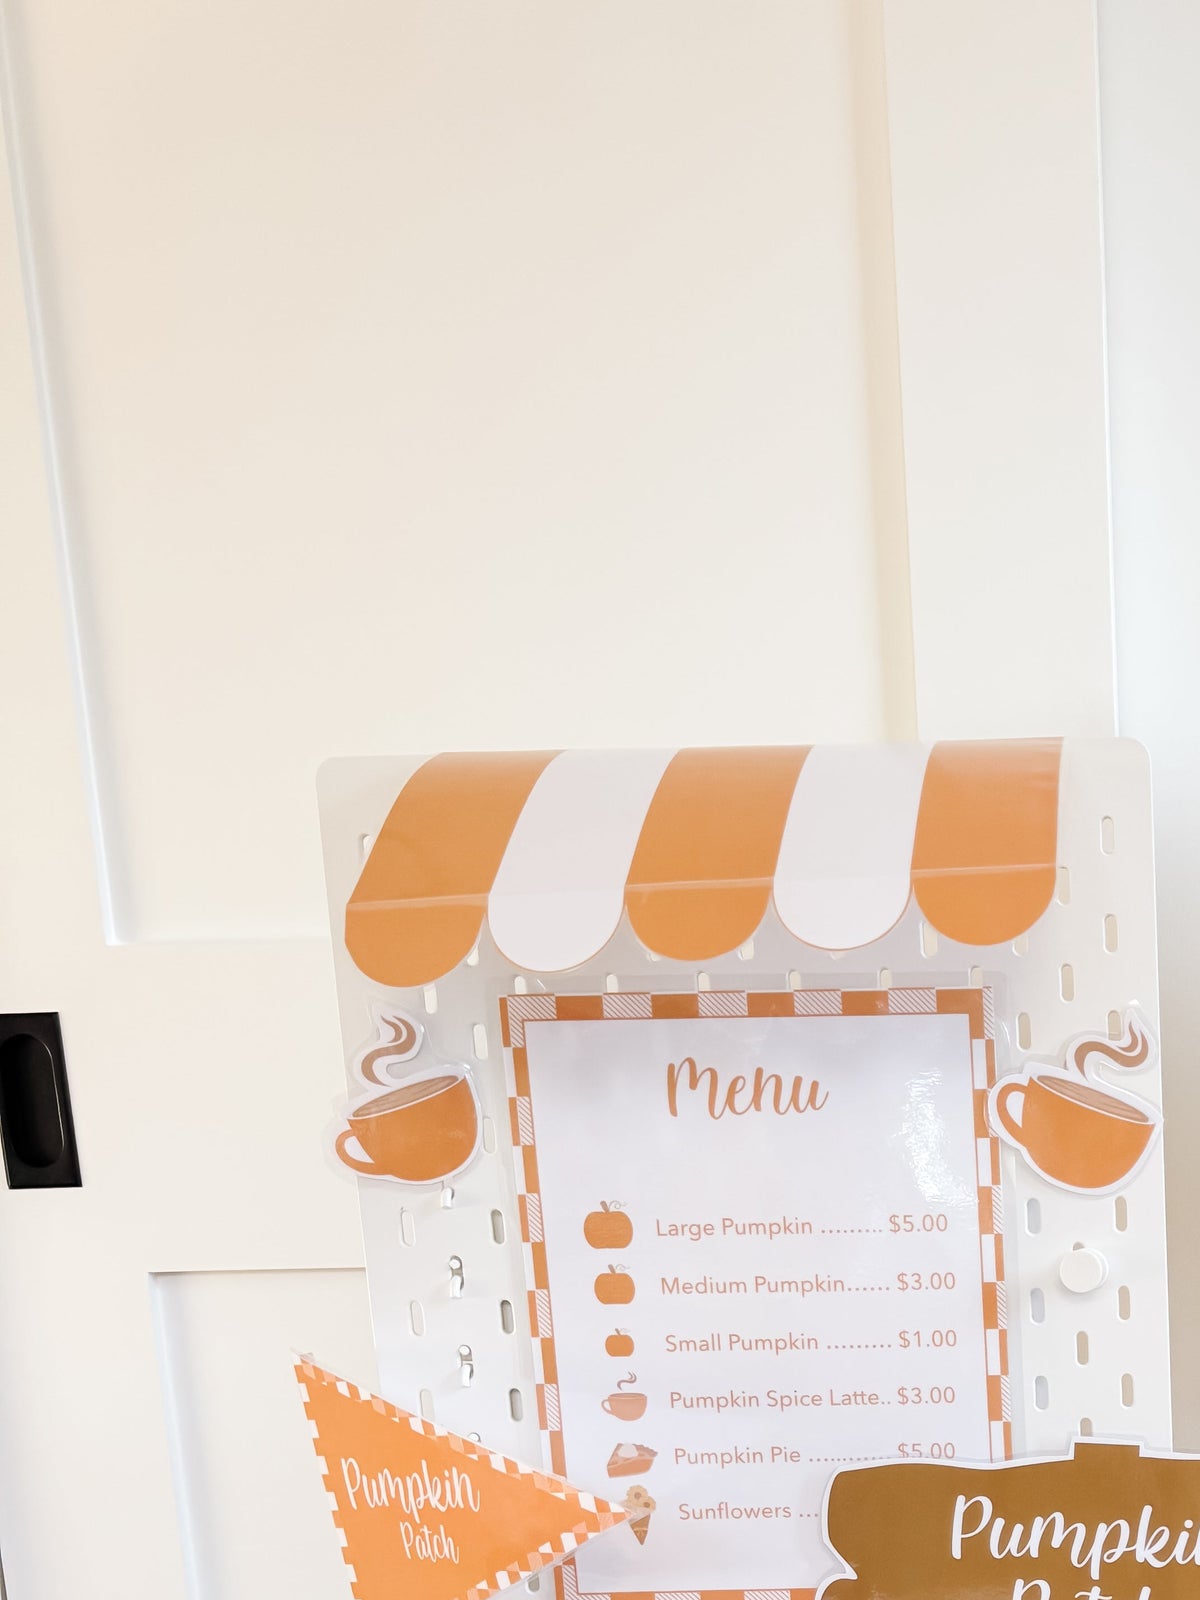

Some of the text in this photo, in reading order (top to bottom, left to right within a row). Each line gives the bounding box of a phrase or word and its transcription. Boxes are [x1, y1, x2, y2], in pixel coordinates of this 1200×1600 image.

[667, 1056, 830, 1120] Menu
[656, 1213, 948, 1241] Large Pumpkin $5.00
[660, 1275, 748, 1295] Medium
[897, 1272, 956, 1291] $3.00
[665, 1329, 957, 1355] Small Pumpkin $1.00
[669, 1390, 760, 1413] Pumpkin
[766, 1389, 823, 1412] Spice
[897, 1386, 956, 1405] $3.00
[674, 1446, 764, 1469] Pumpkin
[771, 1445, 801, 1463] Pie
[340, 1457, 480, 1524] Pumpkin
[678, 1502, 792, 1520] Sunflowers
[399, 1521, 460, 1564] Patch
